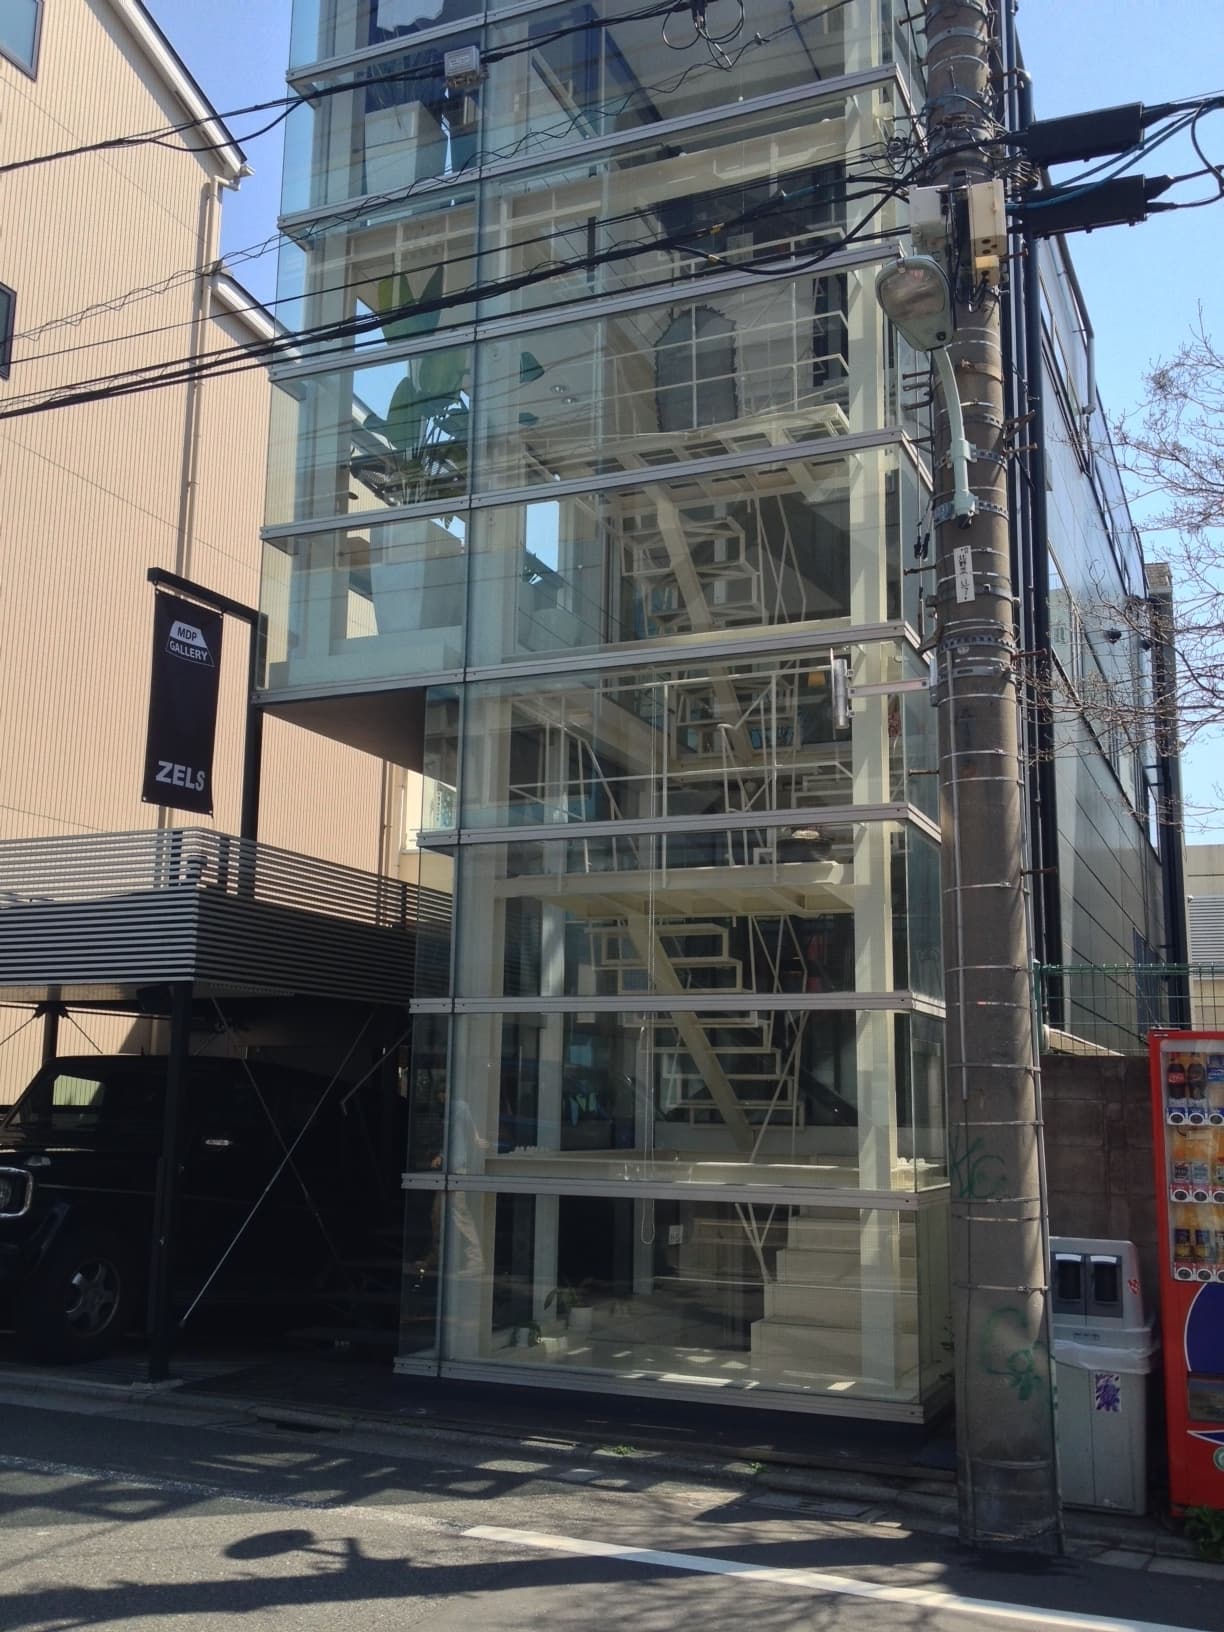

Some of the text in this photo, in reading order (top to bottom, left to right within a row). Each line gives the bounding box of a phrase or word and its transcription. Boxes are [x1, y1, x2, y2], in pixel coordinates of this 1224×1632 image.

[177, 626, 197, 641] MDP
[169, 640, 208, 661] GALLERY
[155, 760, 206, 792] ZELS
